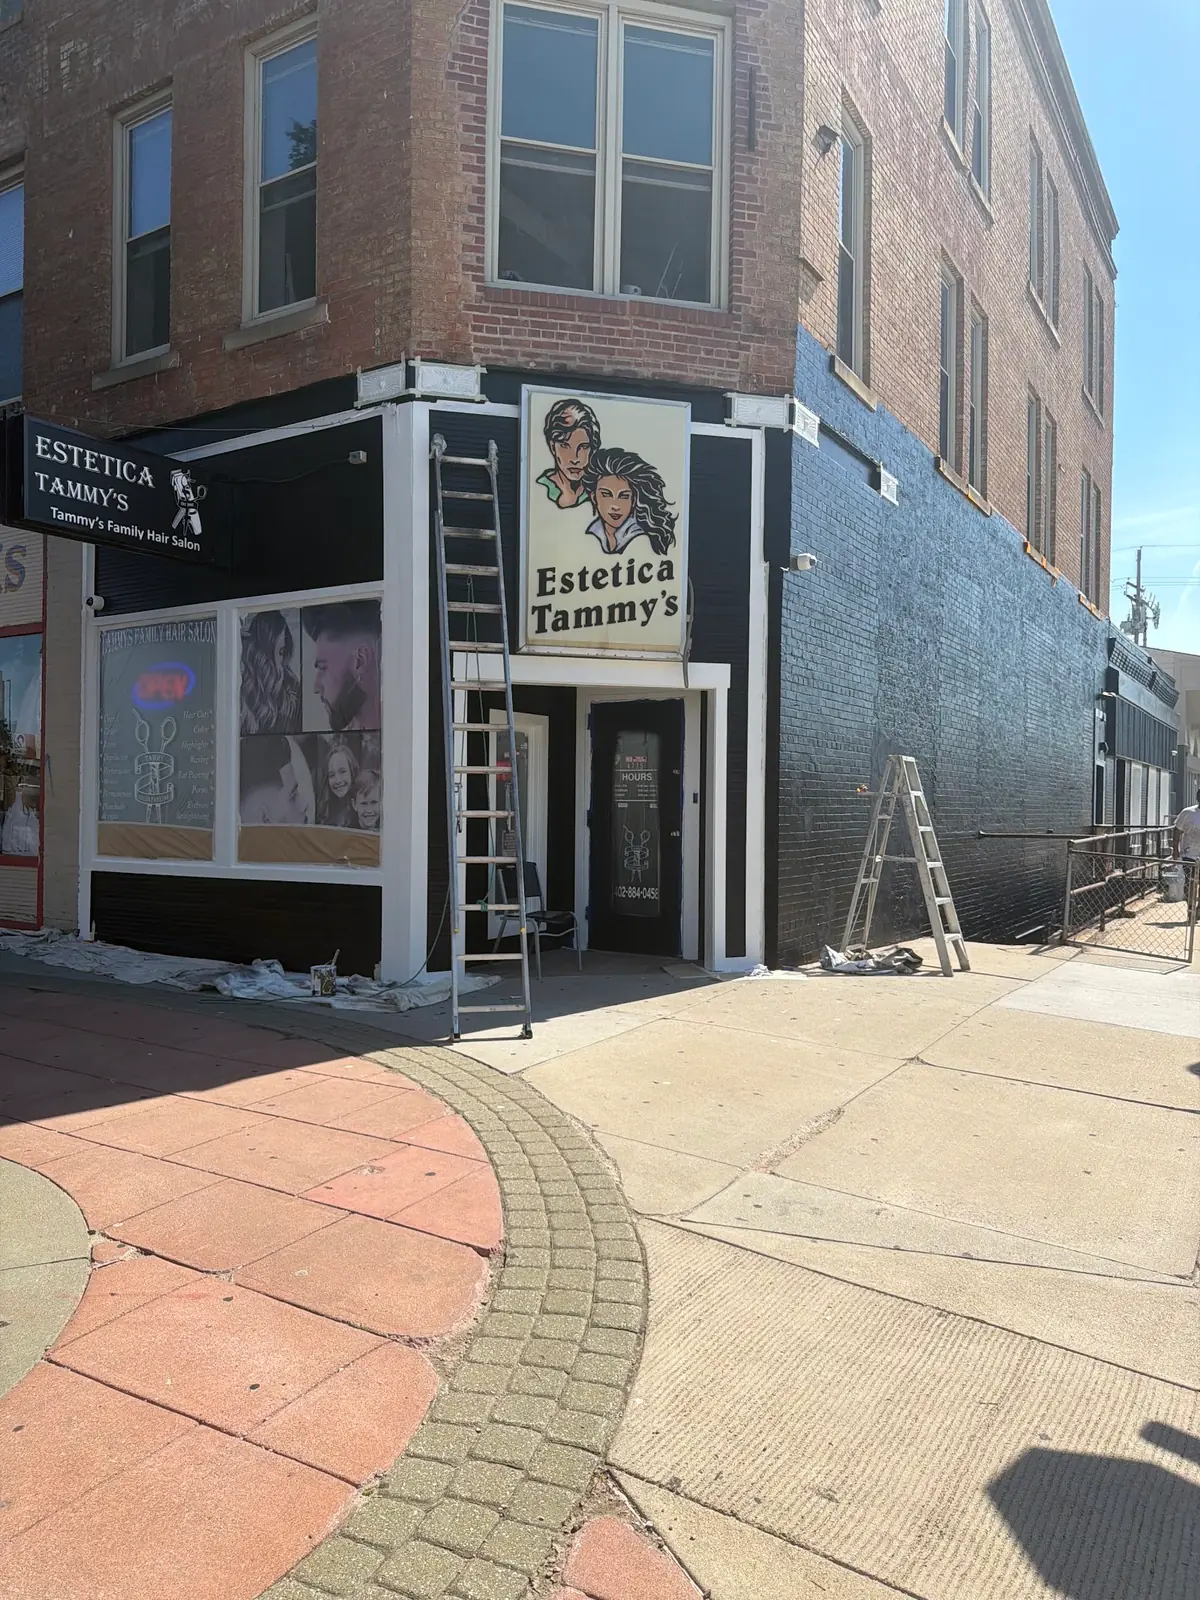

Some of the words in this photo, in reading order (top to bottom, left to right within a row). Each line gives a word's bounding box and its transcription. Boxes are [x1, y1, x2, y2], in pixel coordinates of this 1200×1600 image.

[35, 435, 155, 488] ESTETICA
[35, 472, 129, 511] TAMMY'S
[51, 507, 104, 530] Tammy's
[107, 520, 144, 540] Family
[147, 532, 169, 545] Hair
[172, 536, 200, 551] Salon
[536, 558, 674, 597] Estetica
[531, 590, 679, 634] Tammy's
[134, 624, 165, 645] FAMILY
[166, 623, 186, 642] HAIR
[188, 621, 216, 644] SALON
[137, 672, 188, 702] OPEN
[622, 773, 652, 782] HOURS
